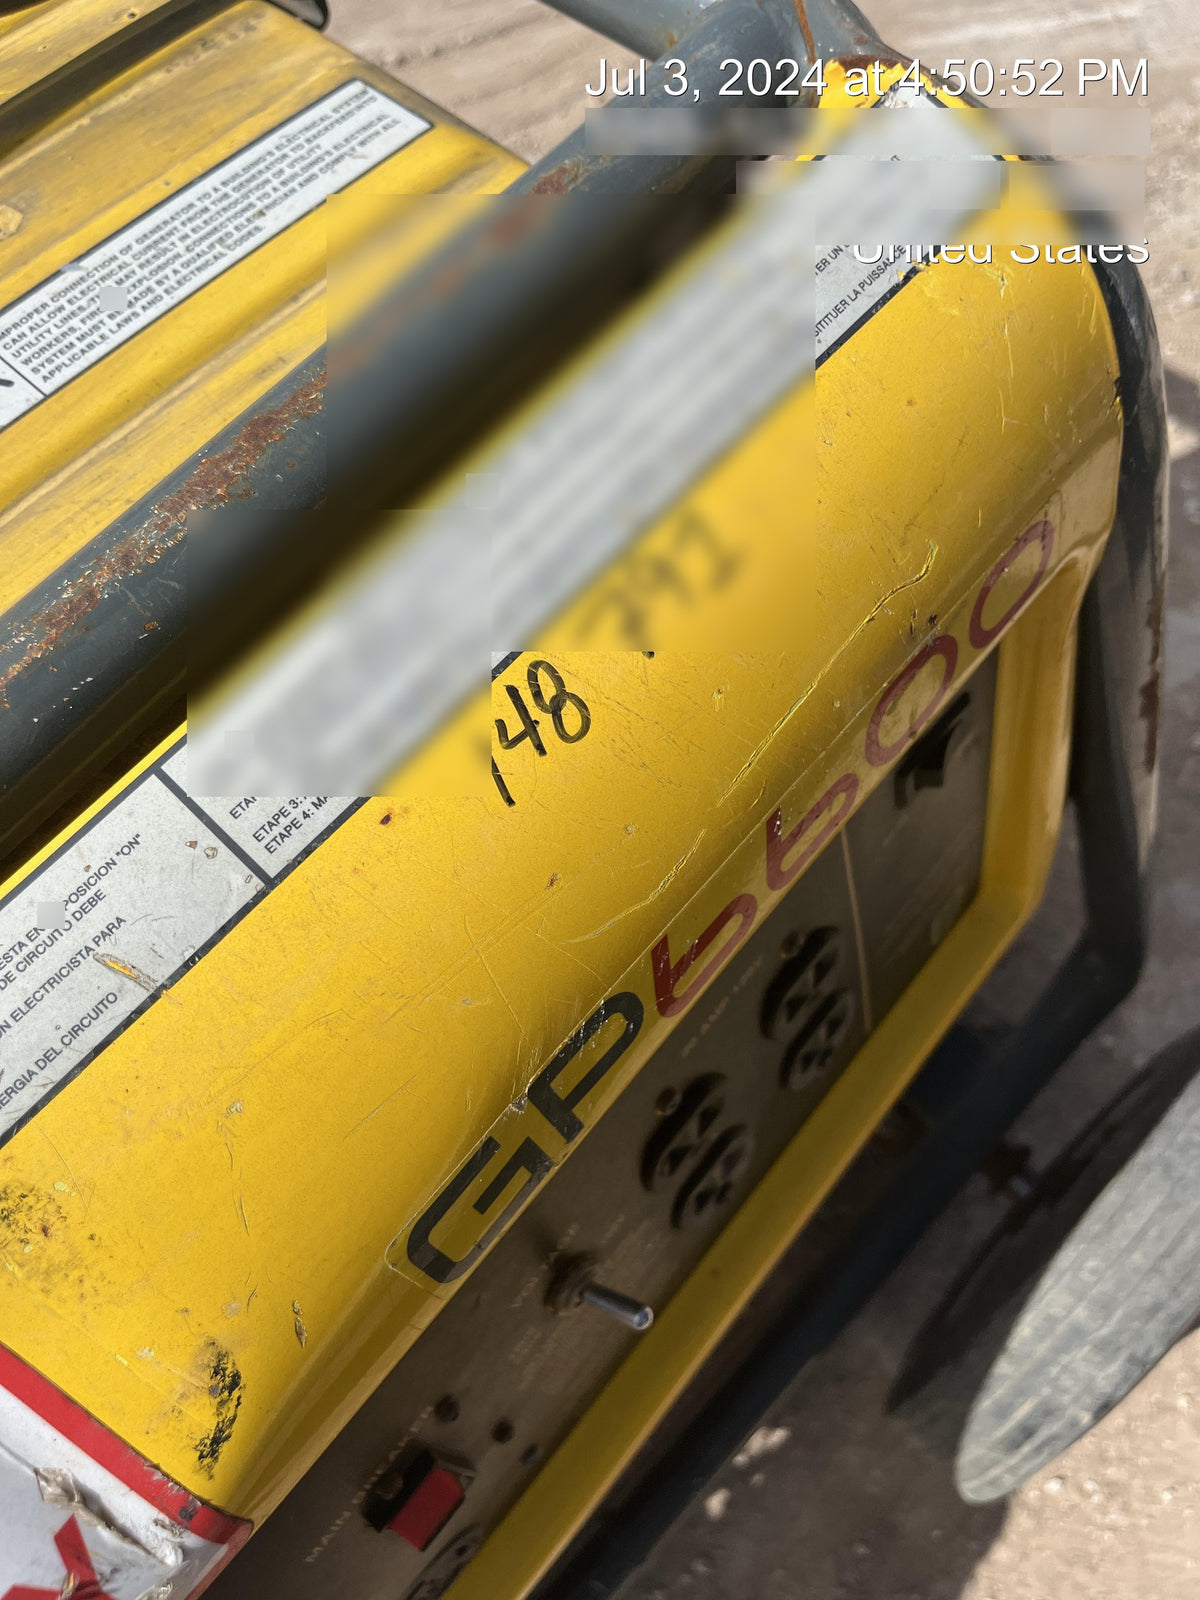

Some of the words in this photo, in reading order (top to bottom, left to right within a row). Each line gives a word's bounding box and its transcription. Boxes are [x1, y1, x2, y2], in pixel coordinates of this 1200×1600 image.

[3, 330, 26, 351] CAN
[29, 304, 66, 332] ALLOW
[67, 261, 131, 305] ELECTRICAL
[131, 226, 181, 261] CURRENT
[181, 206, 211, 227] FROM
[211, 193, 233, 206] THE
[232, 153, 290, 193] GENERATOR
[290, 143, 305, 153] TO
[12, 330, 53, 358] UTILITY
[115, 270, 137, 287] MAY
[137, 241, 178, 270] RESULT
[178, 233, 191, 244] IN
[190, 179, 272, 234] ELECTROCUTION
[271, 168, 285, 179] OF
[286, 144, 322, 170] UTILITY
[21, 325, 82, 366] WORKERS,
[186, 202, 257, 252] CONNECTIONS
[256, 192, 271, 203] TO
[272, 186, 281, 194] A
[332, 114, 392, 151] ELECTRICAL
[31, 342, 75, 375] SYSTEM
[76, 320, 107, 343] MUST
[155, 274, 171, 287] BY
[172, 269, 181, 277] A
[299, 172, 319, 188] AND
[357, 130, 383, 148] WITH
[382, 118, 402, 133] ALL
[51, 254, 119, 303] CONNECTION
[119, 244, 133, 257] OF
[136, 203, 196, 245] GENERATOR
[197, 192, 212, 203] TO
[221, 151, 275, 188] BUILDING'S
[275, 113, 333, 151] ELECTRICAL
[830, 245, 844, 259] UN
[42, 333, 109, 383] APPLICABLE
[109, 312, 140, 335] LAWS
[140, 294, 164, 312] AND
[164, 250, 230, 296] ELECTRICAL
[849, 286, 863, 302] LA
[115, 833, 141, 856] "ON"
[252, 806, 291, 842] ETAPE
[264, 817, 303, 854] ETAPE
[302, 808, 314, 820] 4:
[72, 889, 107, 921] DEBE
[10, 945, 95, 1023] ELECTRICISTA
[92, 916, 127, 947] PARA
[35, 1047, 63, 1071] DEL
[60, 992, 118, 1047] CIRCUITO
